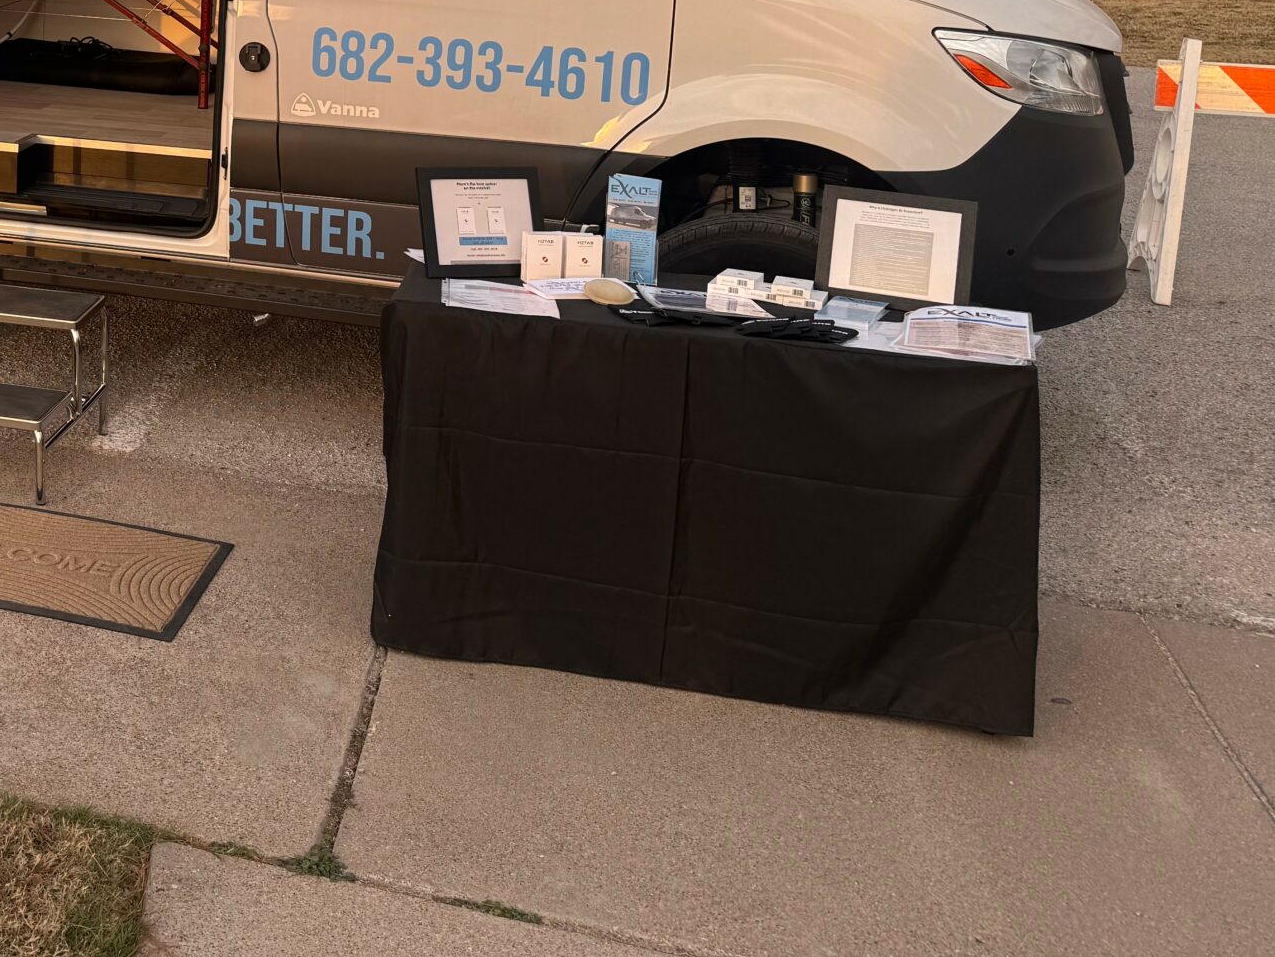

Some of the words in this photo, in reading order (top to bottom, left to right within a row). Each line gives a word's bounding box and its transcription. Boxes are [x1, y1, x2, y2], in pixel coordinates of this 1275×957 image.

[311, 26, 651, 106] 682-393-4610
[316, 100, 380, 119] Vanna
[611, 177, 652, 198] EXALT
